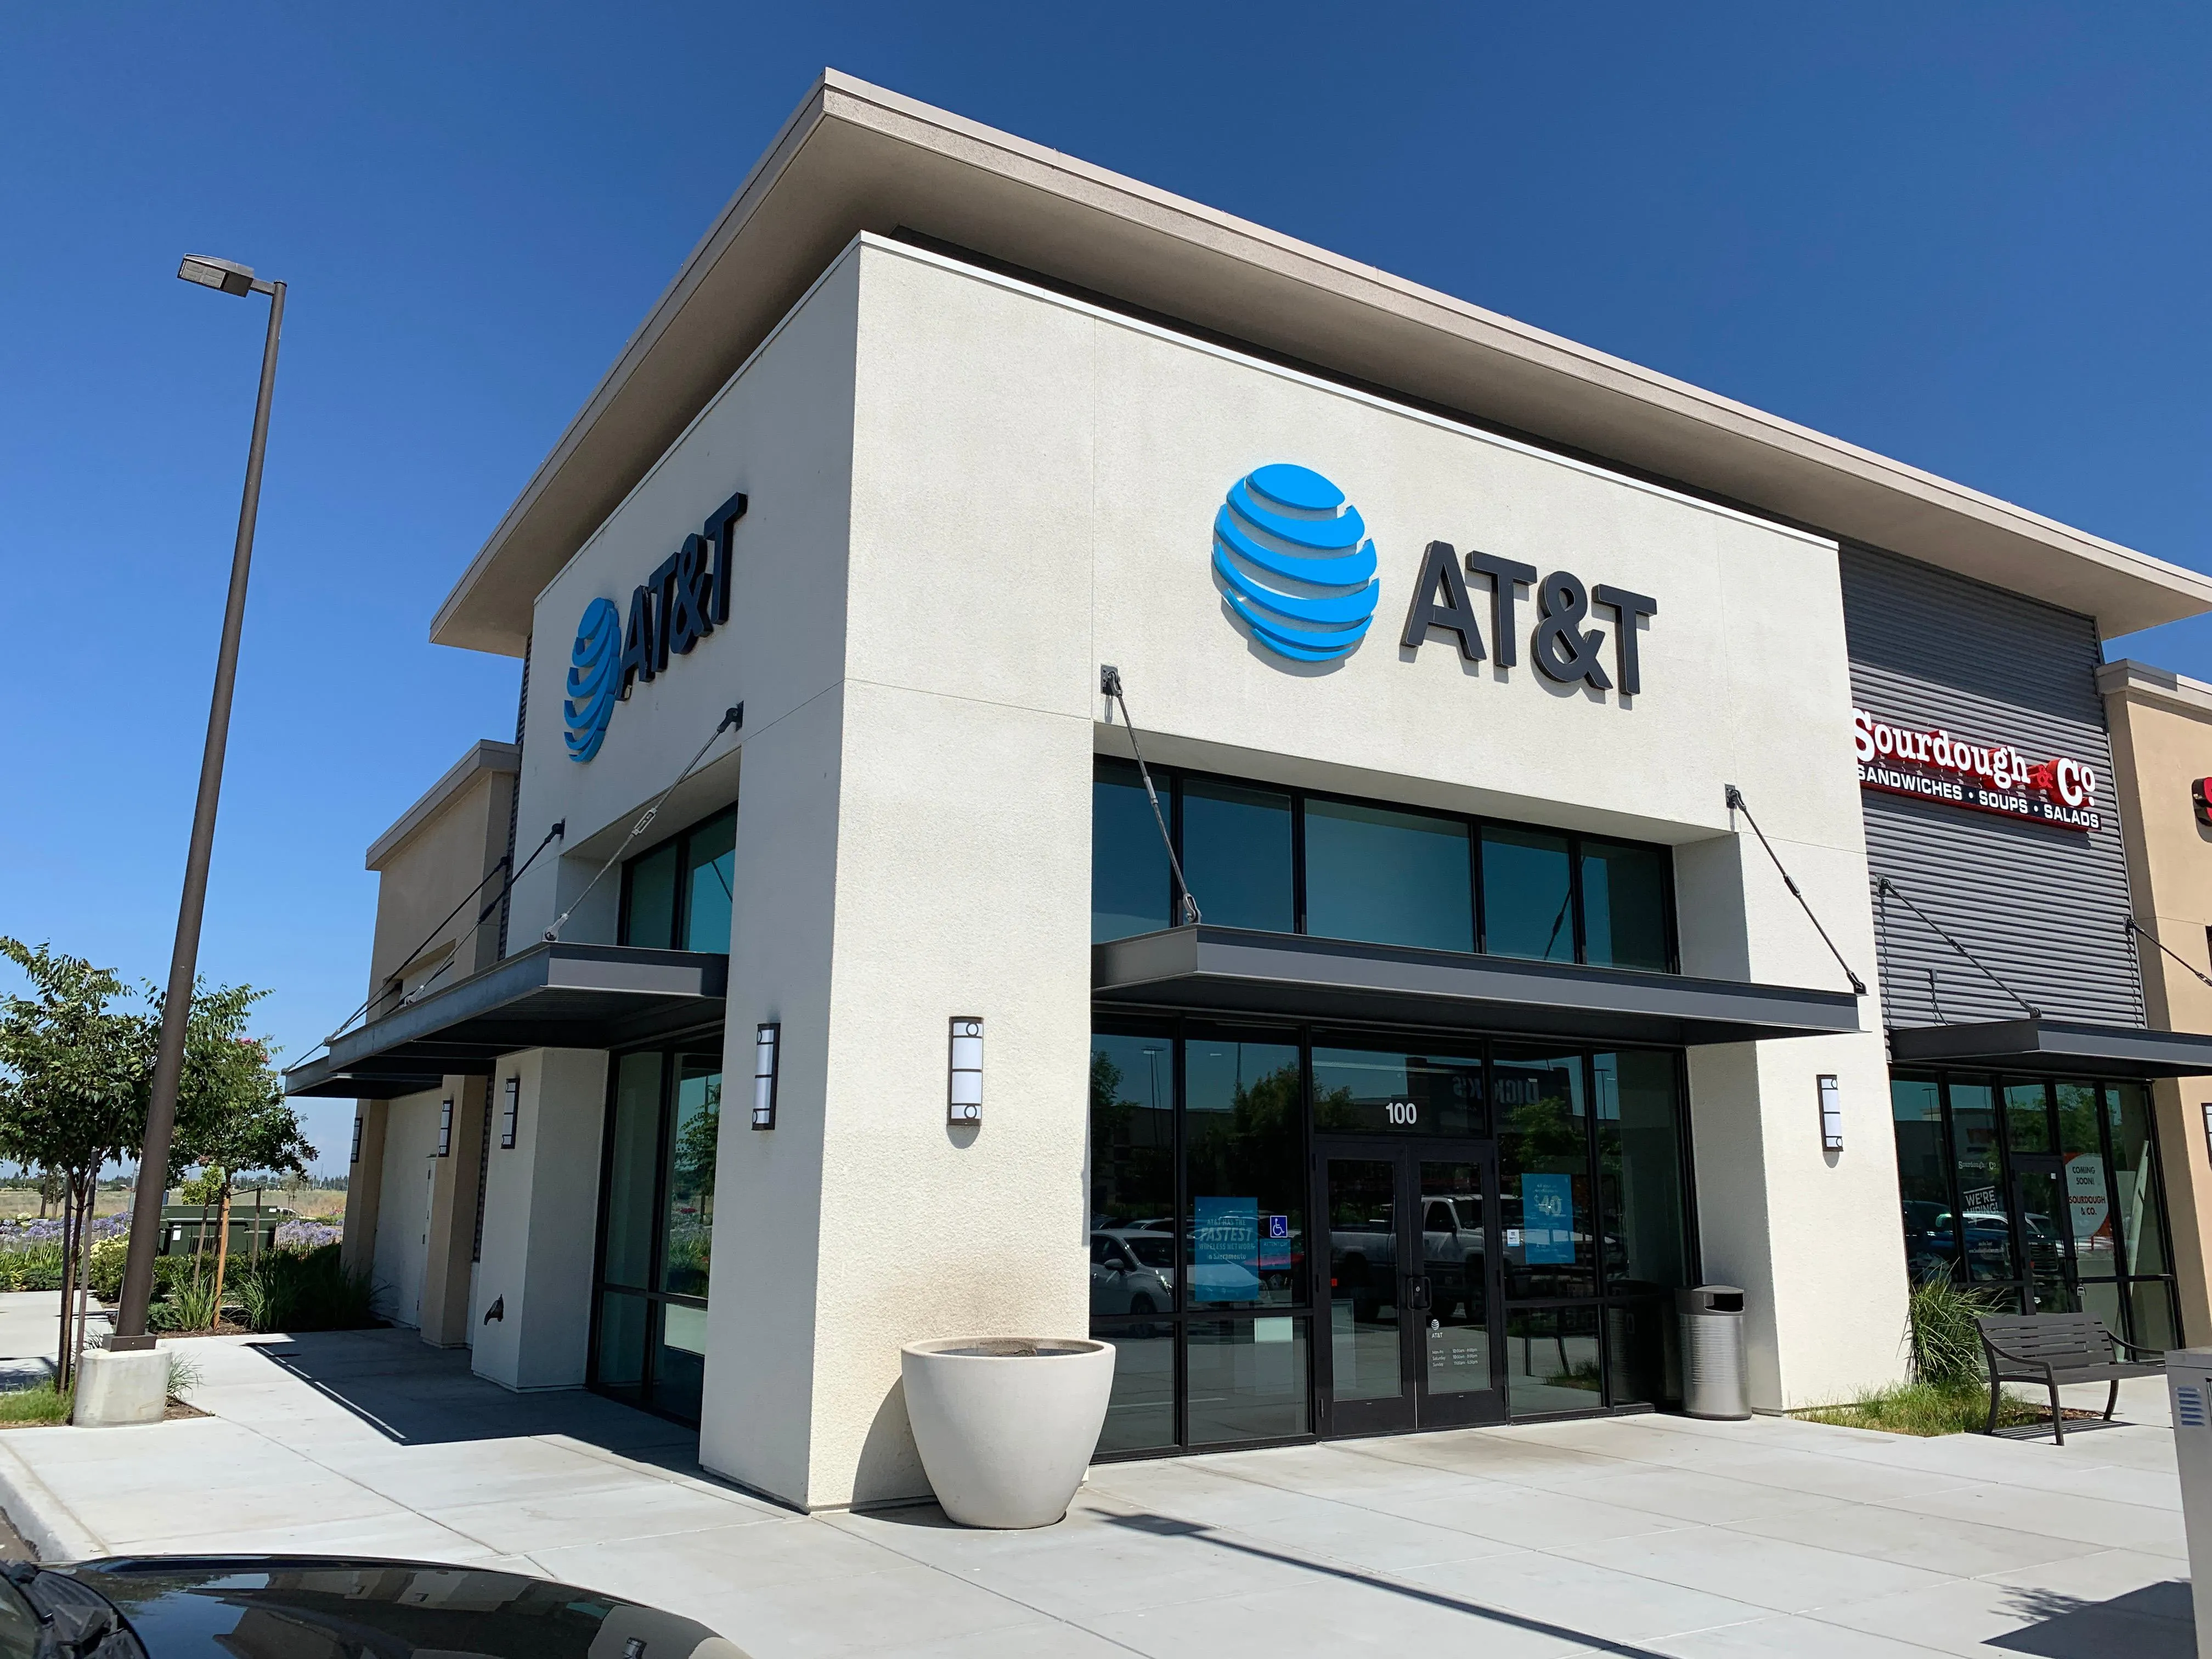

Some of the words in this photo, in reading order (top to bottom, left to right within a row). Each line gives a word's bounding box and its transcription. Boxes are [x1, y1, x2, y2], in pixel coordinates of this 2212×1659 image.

[615, 492, 748, 701] AT&T
[1400, 540, 1657, 696] AT&T
[1852, 708, 2031, 789] Sourdough
[2036, 765, 2053, 789] &
[2057, 758, 2096, 806] Co.
[1857, 764, 1962, 800] SANDWICHES
[1979, 790, 2028, 814] SOUPS
[2044, 804, 2099, 828] SALADS
[1385, 1102, 1417, 1124] 100
[1965, 1190, 1995, 1206] WE'RE
[2086, 1207, 2097, 1215] CO.
[1200, 1227, 1253, 1242] FASTEST
